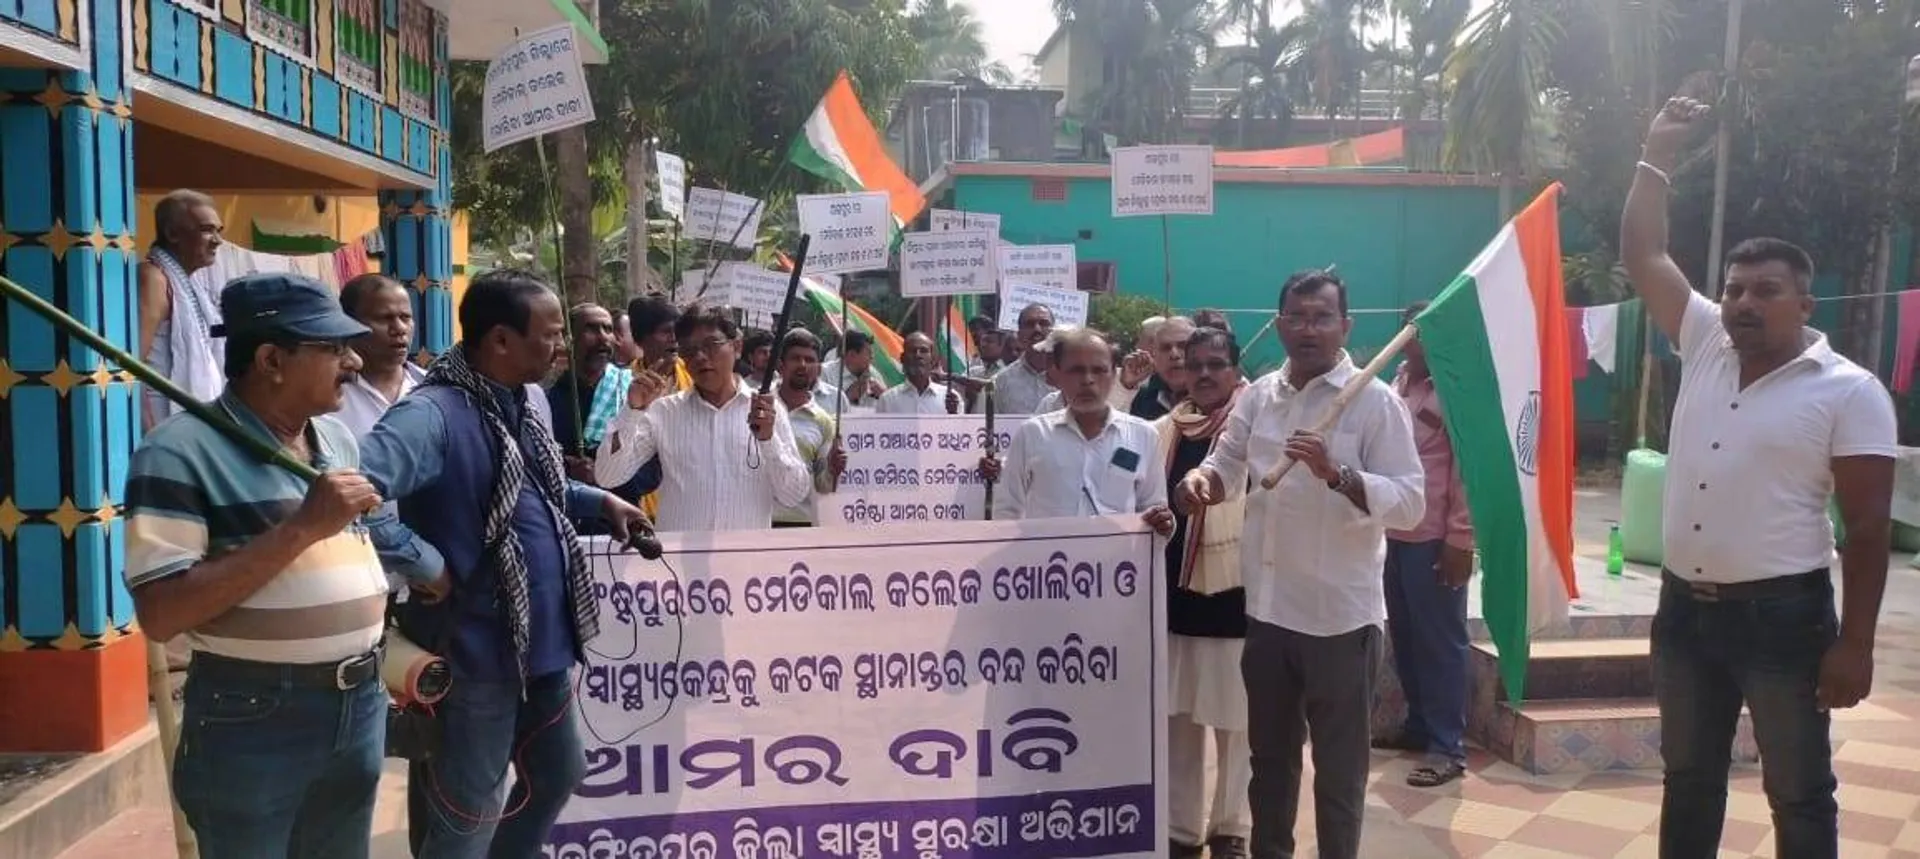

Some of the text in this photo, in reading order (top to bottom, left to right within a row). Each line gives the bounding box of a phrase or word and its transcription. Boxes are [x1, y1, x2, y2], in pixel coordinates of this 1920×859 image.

[847, 433, 875, 451] ଗ୍ରାମ
[874, 462, 920, 486] ଜମିରେ
[890, 504, 928, 522] ଆମର
[594, 551, 1138, 627] ଂହପୁରରେ ମେଡିକାଲ କଲେଜ ଖୋଲିବା ଓ
[768, 655, 843, 694] କଟକ
[854, 650, 968, 699] ସ୍ଥାନାନ୍ତର
[978, 647, 1026, 685] ବନ୍ଦ
[1036, 633, 1118, 685] କରିବା
[572, 707, 1080, 799] ଆମର ଦାବି
[1020, 799, 1141, 841] ଅଭିଯାନ
